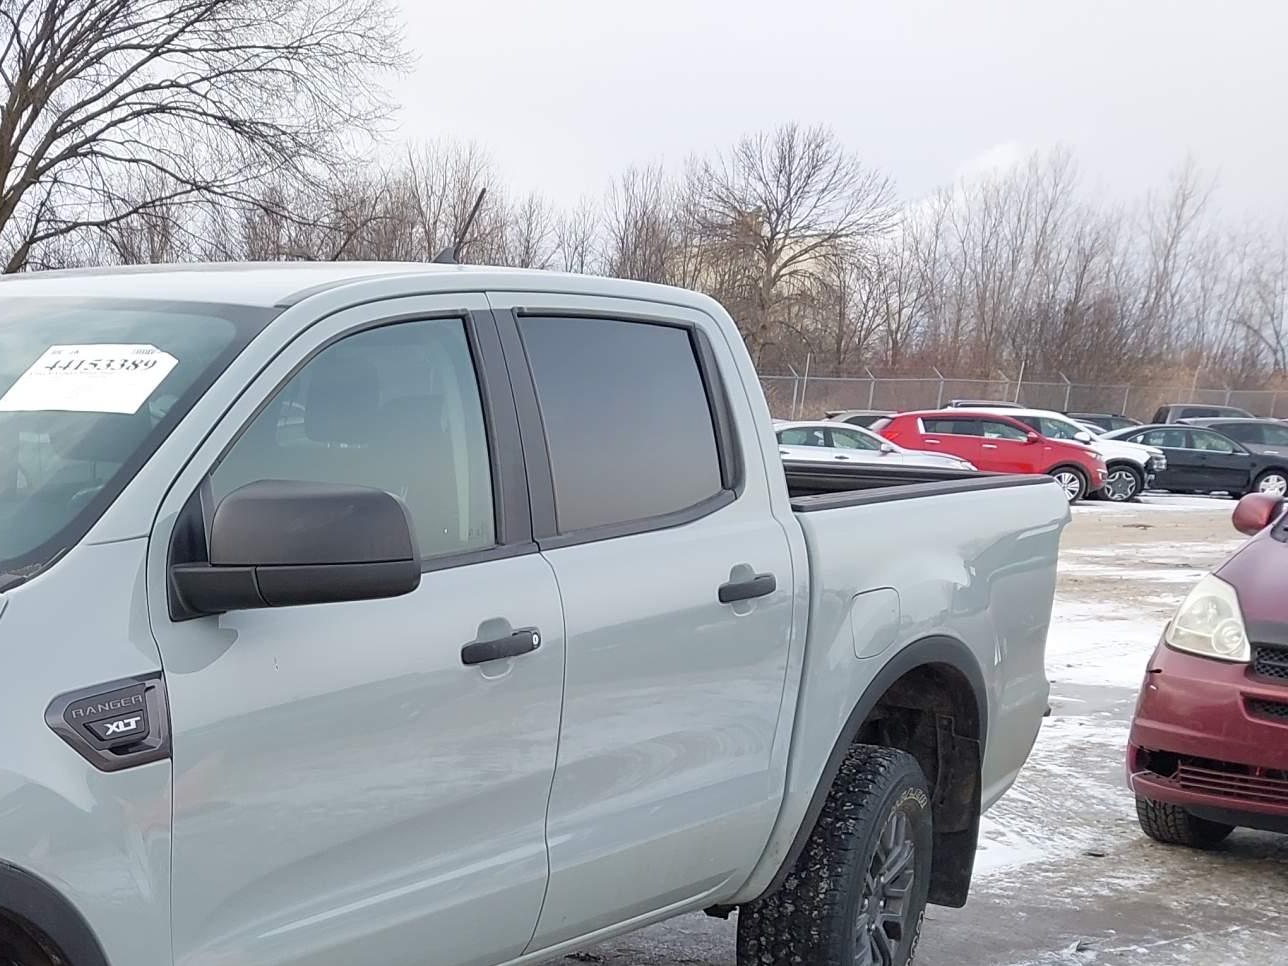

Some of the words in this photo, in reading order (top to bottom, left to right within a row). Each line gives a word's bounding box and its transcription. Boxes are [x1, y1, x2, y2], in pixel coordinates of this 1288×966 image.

[44, 359, 158, 371] 44153389
[72, 694, 143, 719] RANGER
[103, 716, 141, 736] XLT
